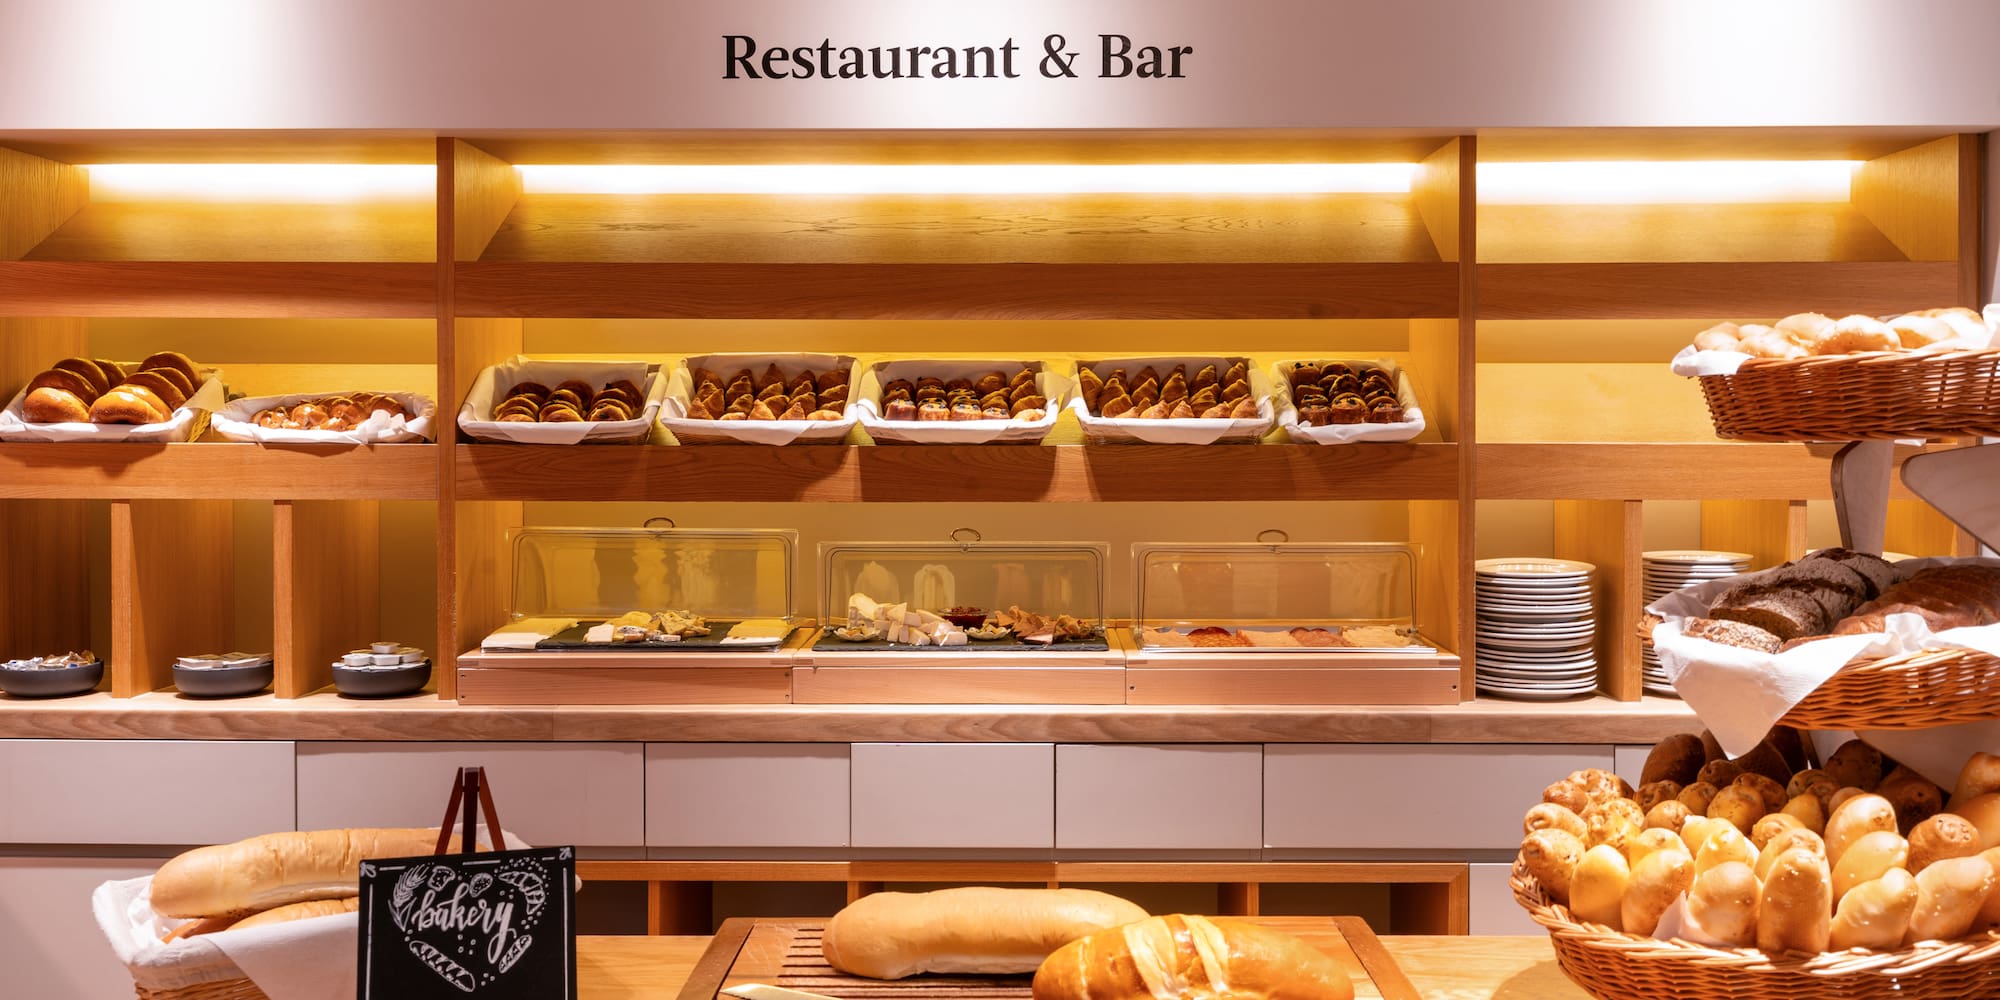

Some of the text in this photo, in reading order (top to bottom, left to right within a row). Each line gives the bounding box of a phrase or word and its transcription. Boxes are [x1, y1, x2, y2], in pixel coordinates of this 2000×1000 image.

[722, 34, 1193, 79] Restaurant & Bar
[411, 883, 517, 964] bakery
